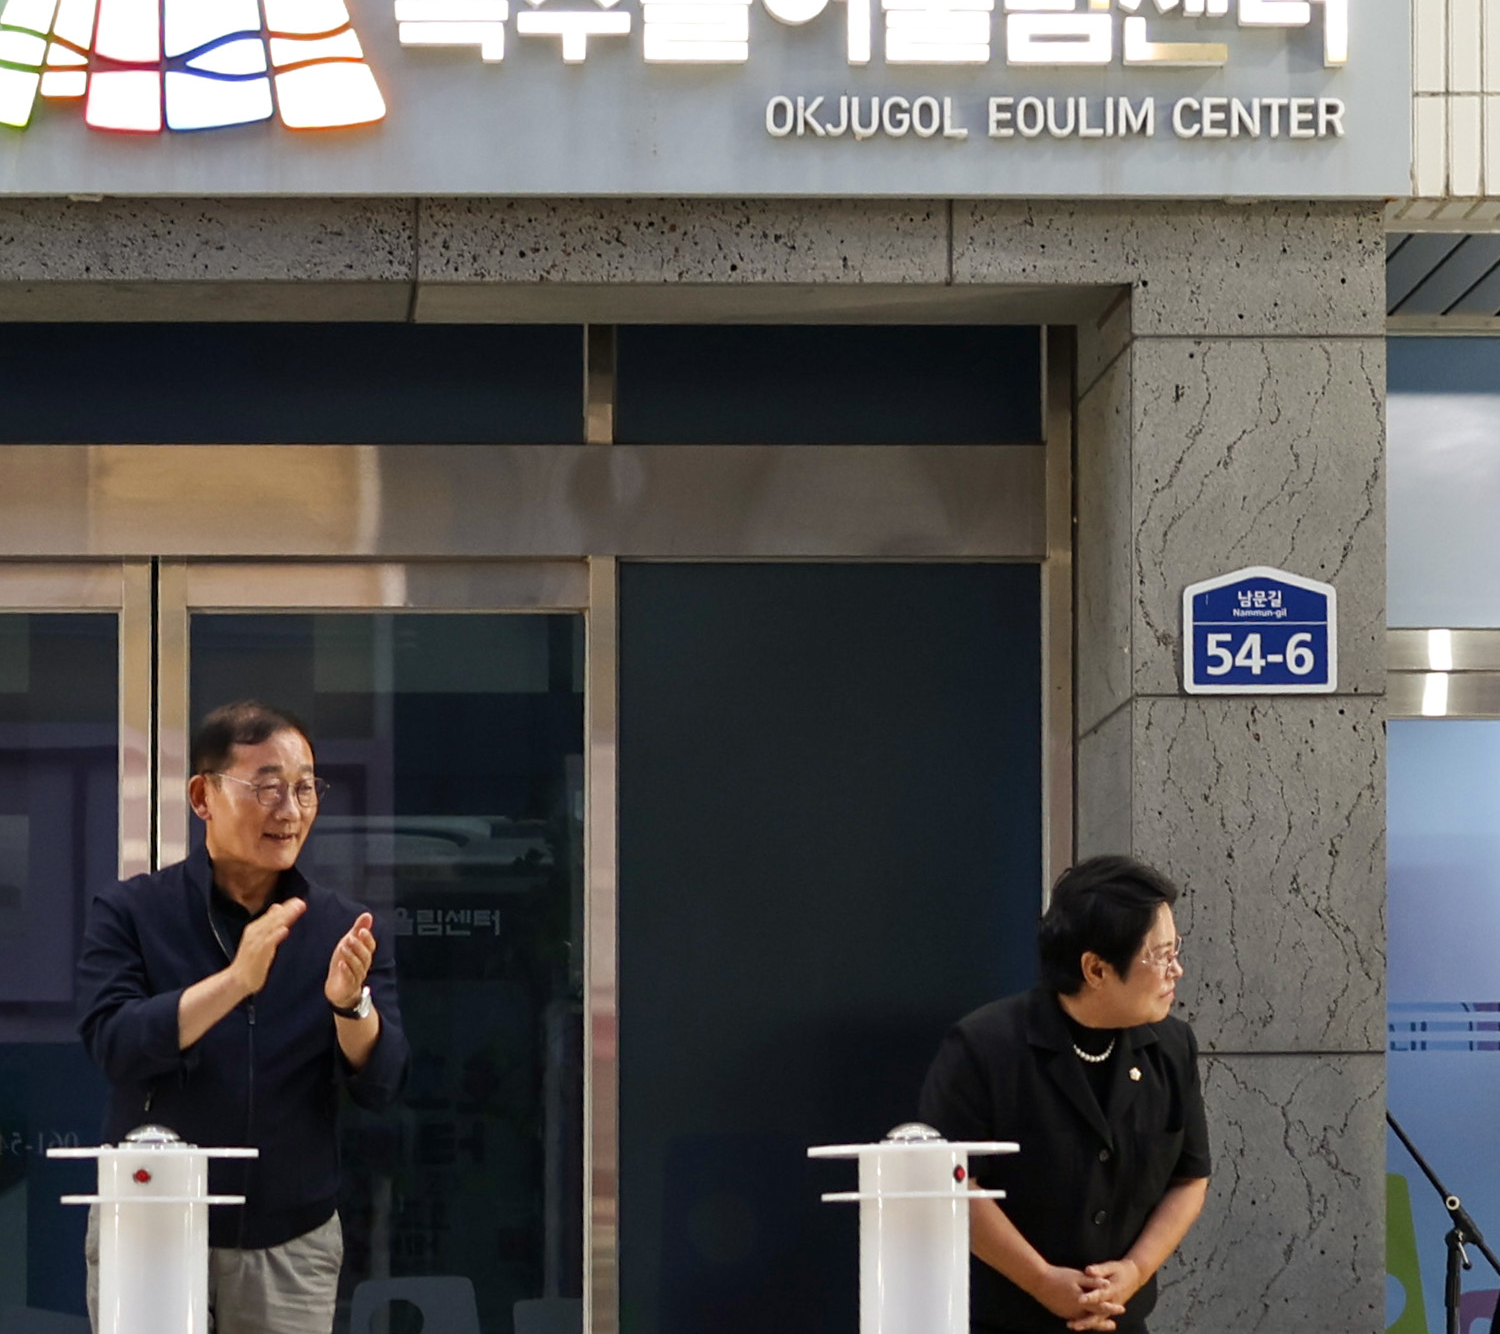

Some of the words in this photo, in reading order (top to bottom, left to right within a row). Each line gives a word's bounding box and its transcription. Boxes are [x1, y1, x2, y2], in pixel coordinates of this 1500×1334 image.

[766, 97, 967, 138] OKJUGOL
[988, 97, 1155, 138] EOULIM
[1172, 97, 1347, 137] CENTER
[1233, 608, 1287, 618] Nammun-gil
[1238, 590, 1282, 607] 남문길
[1206, 632, 1314, 676] 54-6
